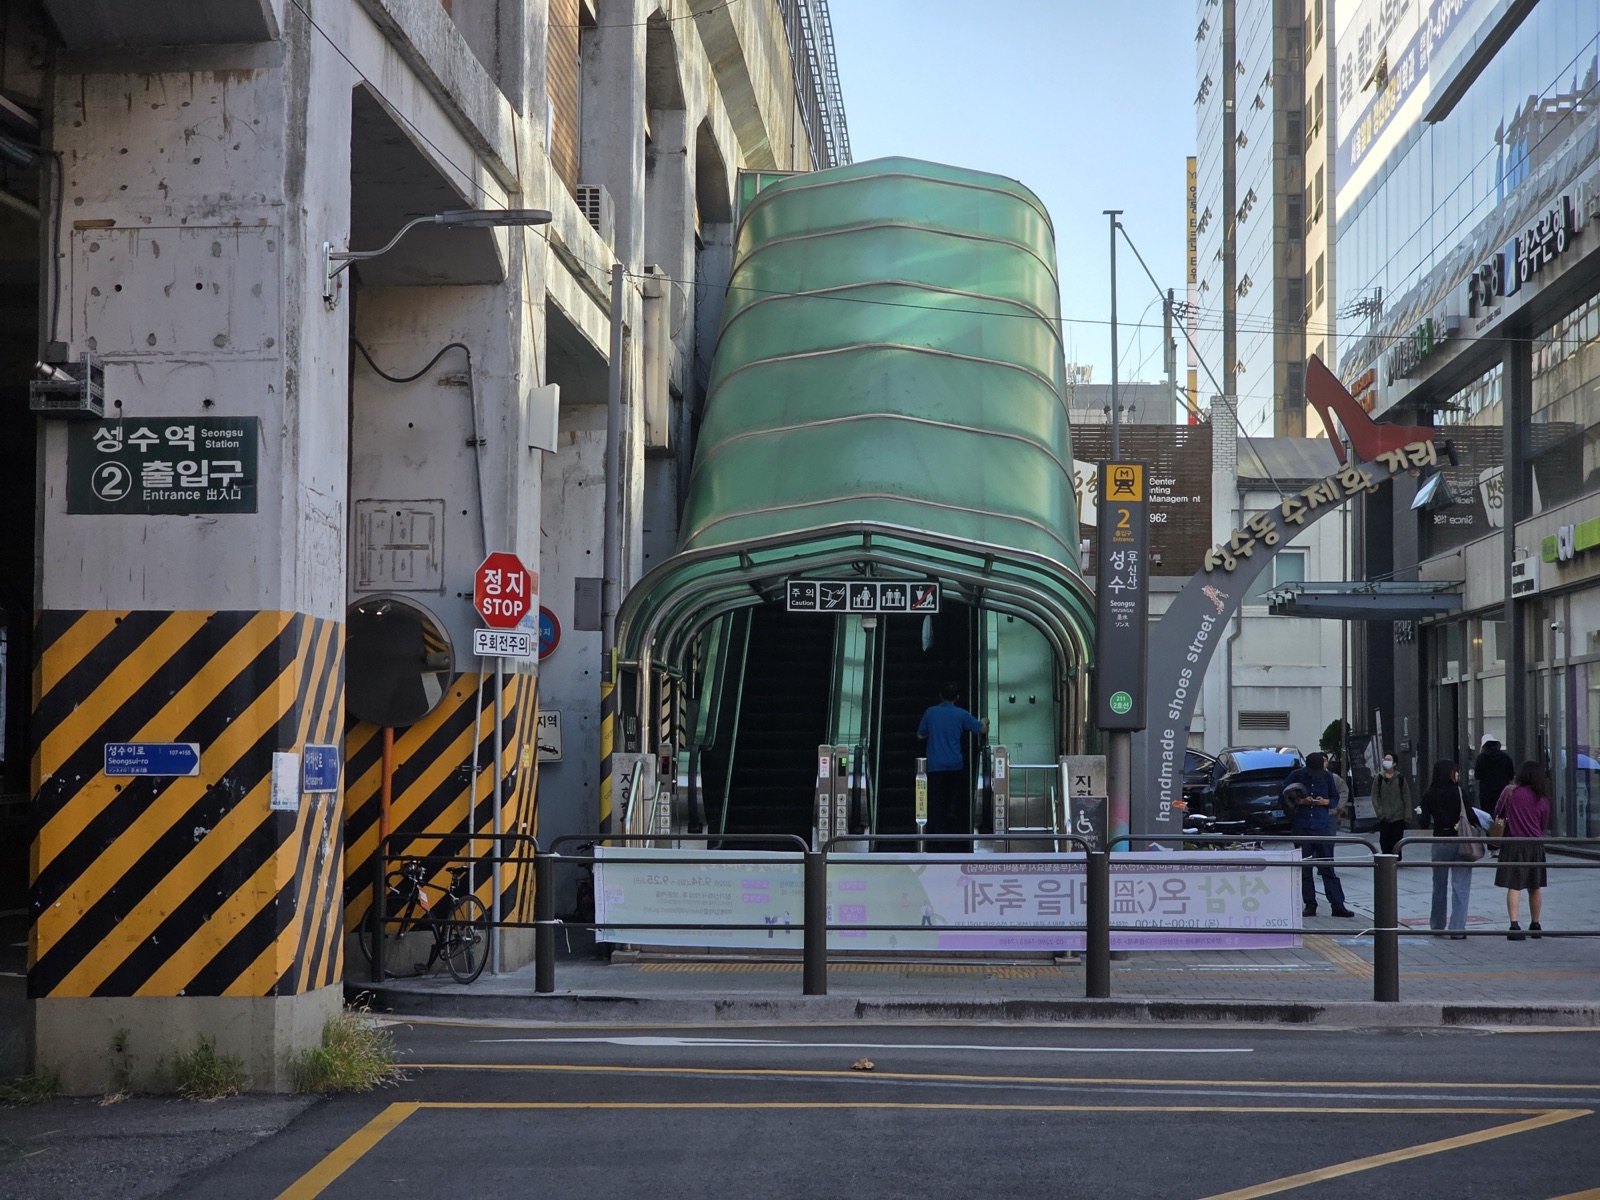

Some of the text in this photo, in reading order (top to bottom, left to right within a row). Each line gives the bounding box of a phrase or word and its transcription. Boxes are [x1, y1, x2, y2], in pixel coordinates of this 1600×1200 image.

[1358, 18, 1371, 86] 불면
[1518, 196, 1566, 282] 광주은행
[92, 425, 195, 453] 성수역
[201, 429, 244, 440] Seongsu
[205, 439, 239, 448] Station
[140, 459, 244, 488] 출입구
[1149, 477, 1177, 486] Center
[142, 489, 201, 500] Entrance
[1204, 440, 1437, 573] 성수동 수제화 거리
[1117, 508, 1130, 528] 2
[1108, 550, 1126, 595] 성수
[1127, 550, 1138, 590] (무신사)
[483, 569, 524, 598] 정지
[482, 598, 523, 617] STOP
[1110, 600, 1135, 608] Seongsu
[478, 634, 528, 654] 우회전주의
[1156, 614, 1216, 822] handmade shoes street
[108, 746, 145, 756] 성수이로
[108, 758, 149, 766] Seongsui-ro
